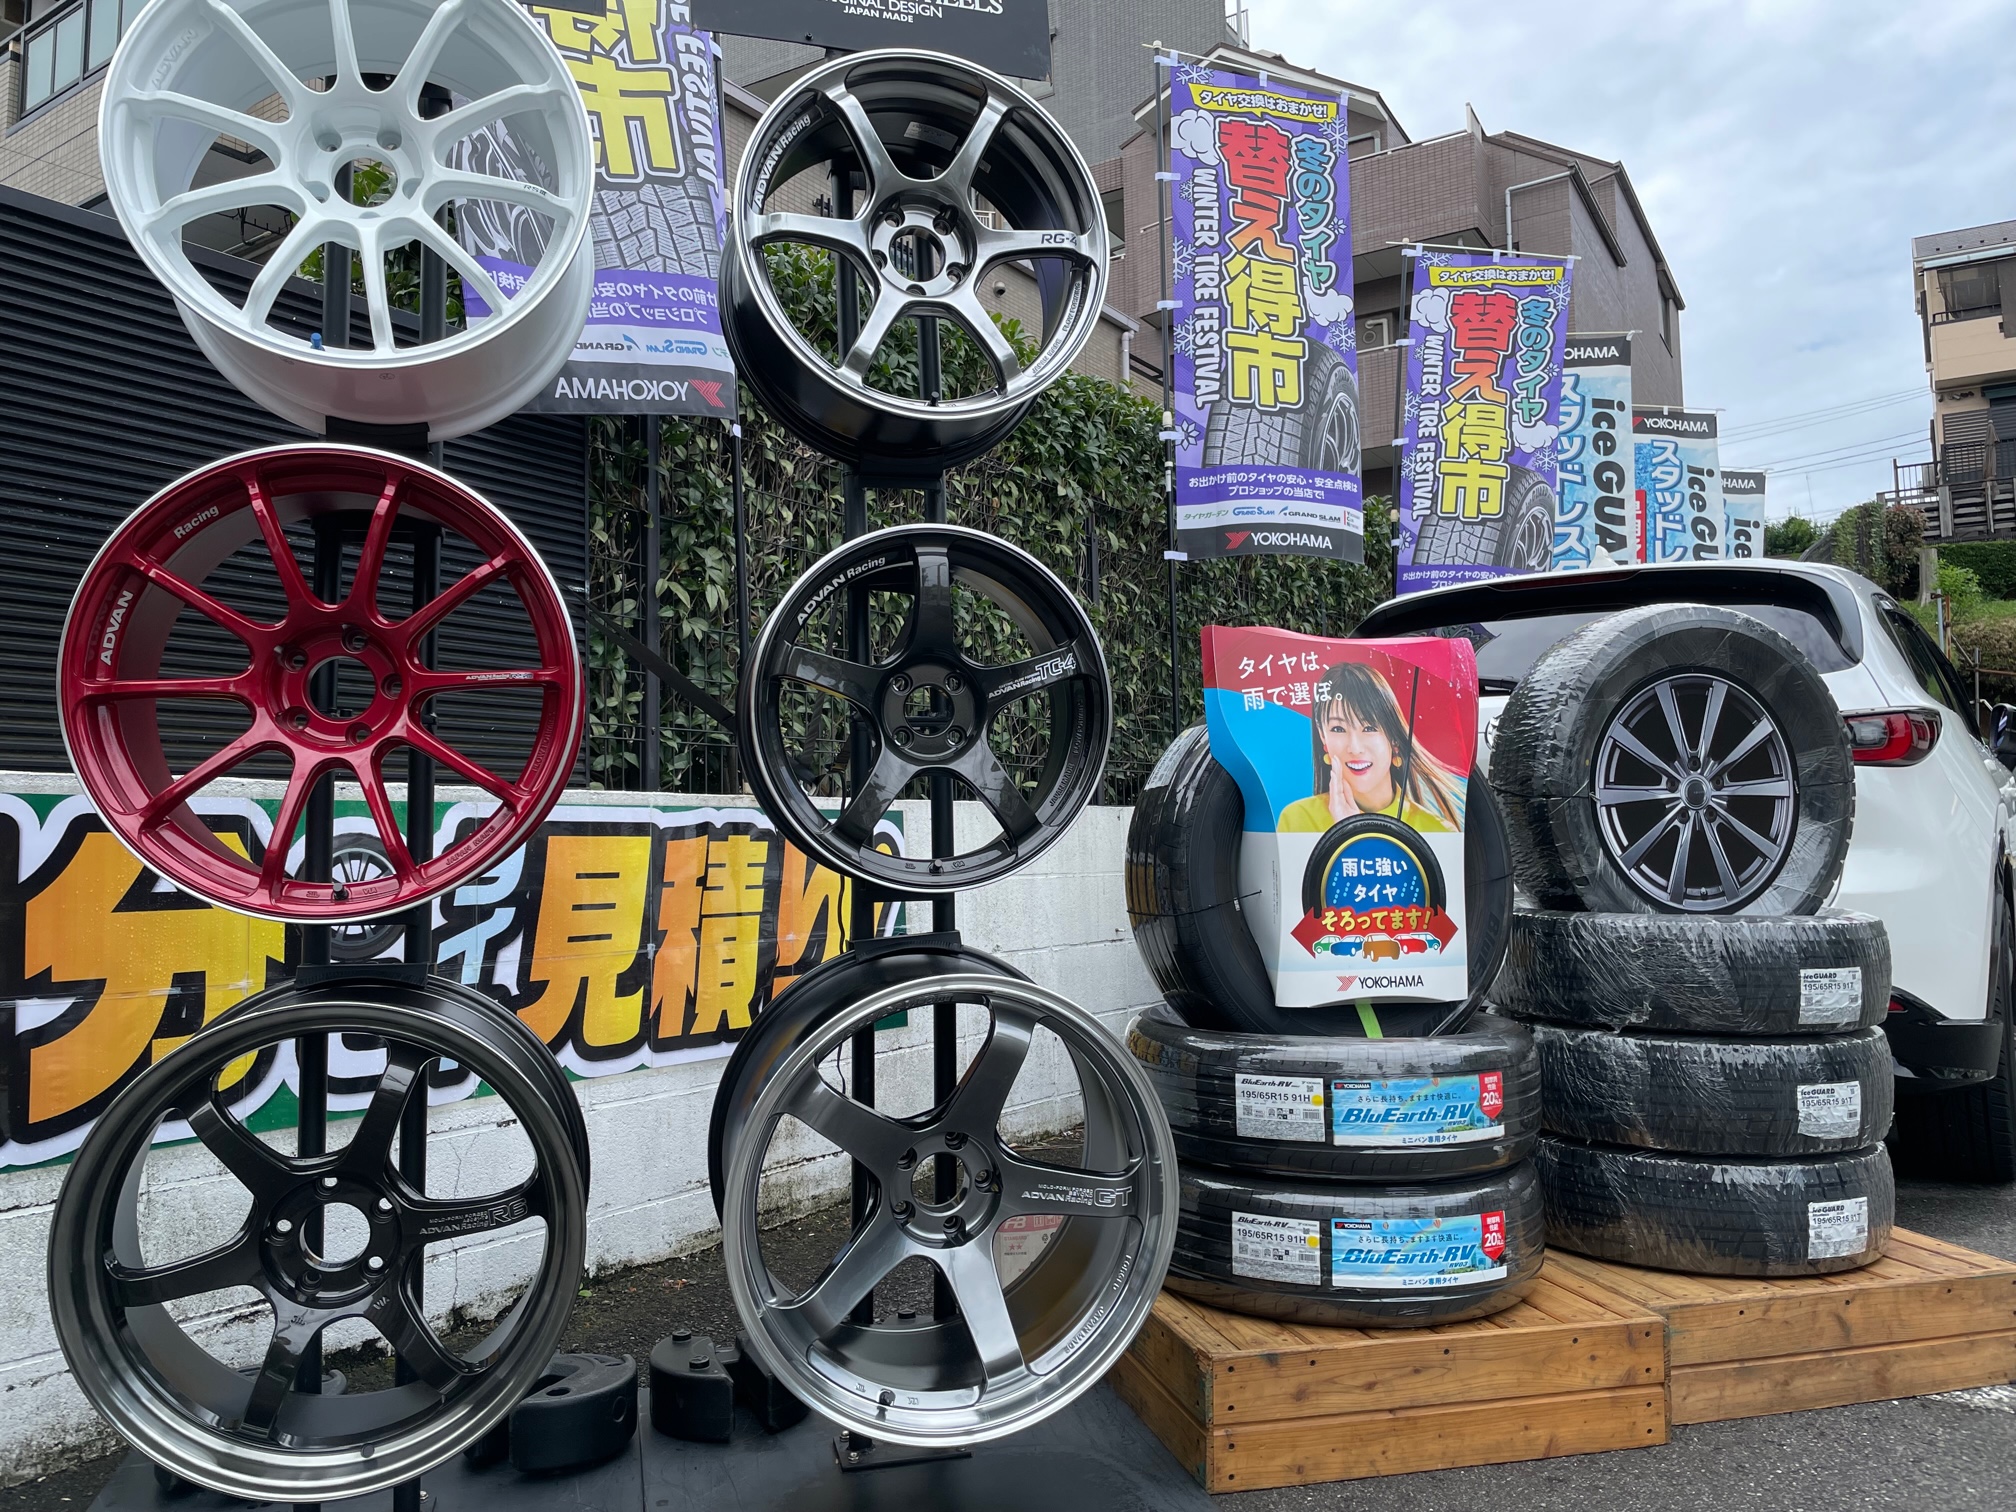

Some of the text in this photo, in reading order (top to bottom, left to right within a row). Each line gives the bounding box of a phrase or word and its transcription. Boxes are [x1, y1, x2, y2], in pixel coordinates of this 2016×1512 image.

[843, 5, 914, 23] JAPAN MADE
[888, 0, 943, 18] DESIGN
[1199, 90, 1328, 118] タイヤ交換はおまかせ!
[752, 114, 811, 209] ADVAN Racing
[1295, 139, 1334, 289] 冬のタイヤ
[1041, 233, 1078, 246] RG-4
[1219, 120, 1304, 408] 替え得市
[1439, 269, 1555, 282] タイヤ交換はおまかせ!
[1193, 168, 1222, 408] WINTER TIRE FESTIVAL
[1515, 299, 1552, 422] 冬のタイヤ
[1440, 293, 1517, 518] 替え得市
[1412, 335, 1445, 520] WINTER TIRE FESTIVAL
[1644, 418, 1709, 433] YOKOHAMA
[1188, 471, 1358, 493] お出かけ前のタイヤの安心・安全点検は
[173, 505, 220, 540] Racing
[1288, 511, 1318, 519] GRAND
[1318, 514, 1341, 522] SLAM
[1251, 531, 1333, 550] YOKOHAMA
[797, 556, 886, 626] ADVAN Racing
[100, 590, 134, 667] ADVAN
[1035, 653, 1077, 681] TC-4
[1237, 650, 1331, 680] タイヤは、
[988, 682, 1021, 699] ADVAN
[1241, 679, 1343, 712] 雨で選ぼ。
[1341, 857, 1408, 877] 雨に強い
[1353, 883, 1399, 902] タイヤ
[1321, 908, 1431, 932] そろってます!
[1358, 975, 1425, 989] YOKOHAMA
[1803, 972, 1837, 980] iceGUARD
[1804, 982, 1854, 991] 195/65R15 91T
[1240, 1078, 1293, 1088] BluEarth-RV
[1800, 1088, 1836, 1096] iceGUARD
[1240, 1090, 1311, 1102] 195/65R15 91H
[1801, 1098, 1840, 1107] 195/65R15
[1341, 1102, 1475, 1124] BluEarth-RV
[1402, 1134, 1458, 1145] ミニバン専用タイヤ
[1021, 1185, 1133, 1208] ADVAN Racing GT
[419, 1223, 461, 1235] ADVAN
[461, 1220, 489, 1231] Racing
[488, 1197, 529, 1227] R6
[1237, 1216, 1289, 1229] BluEarth-RV
[1813, 1215, 1850, 1225] 195/65R15
[1237, 1228, 1285, 1242] 195/65R15
[1287, 1234, 1306, 1244] 91H
[1341, 1243, 1478, 1265] BluEarth-RV
[1402, 1277, 1459, 1286] ミニバン専用タイヤ
